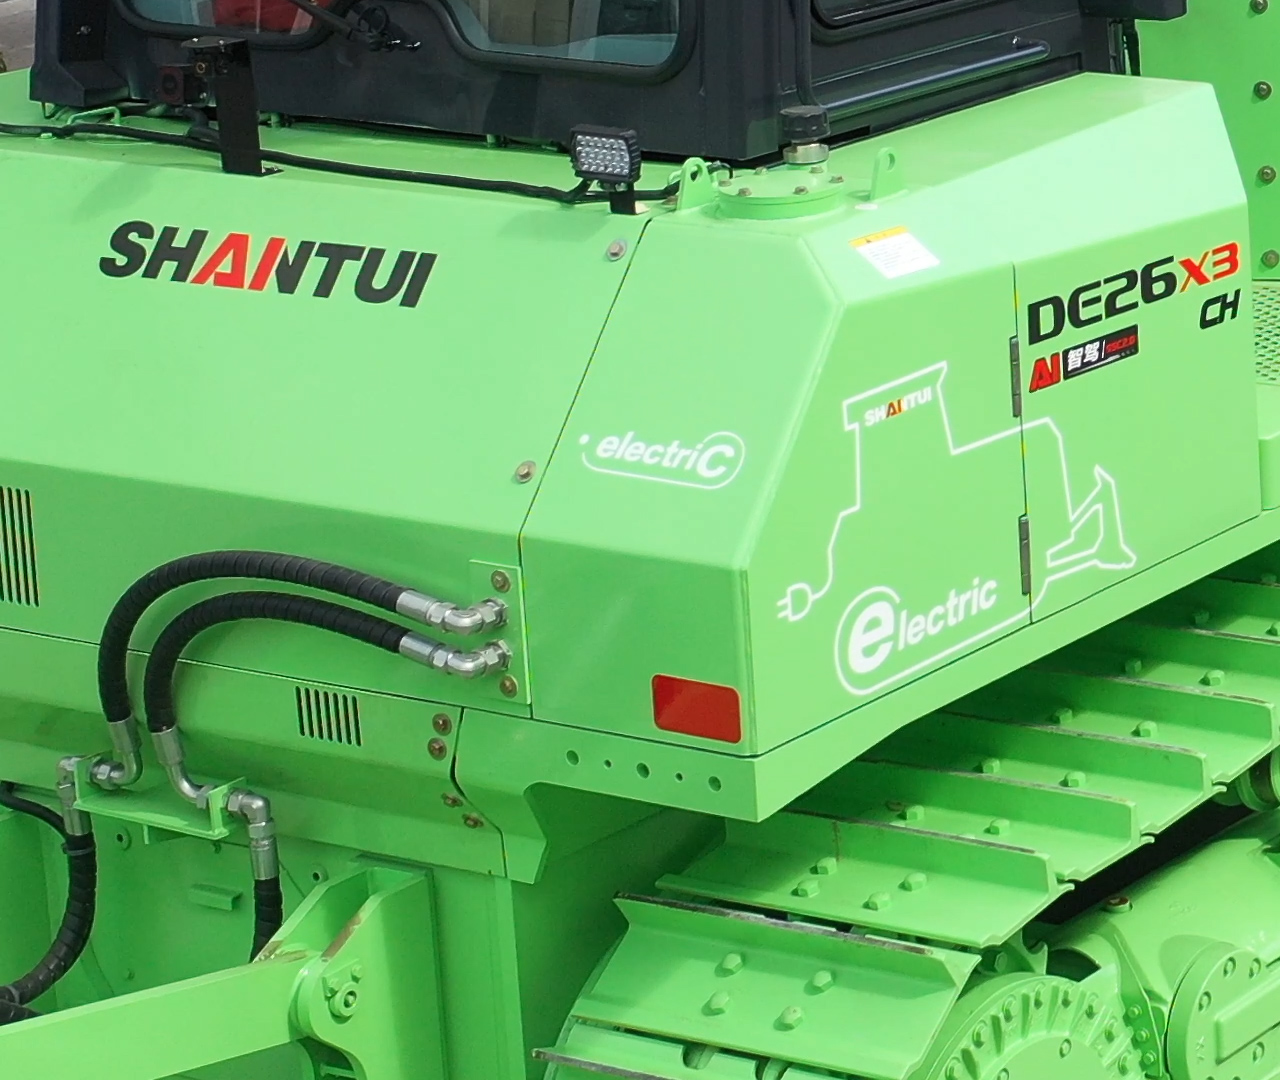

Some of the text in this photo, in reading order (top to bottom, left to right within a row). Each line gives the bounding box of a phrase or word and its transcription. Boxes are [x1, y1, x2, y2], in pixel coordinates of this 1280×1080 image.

[98, 219, 439, 309] SHANTUI
[1027, 241, 1240, 345] DE26X3
[1199, 288, 1242, 330] CH
[1028, 351, 1062, 393] AI
[864, 385, 933, 427] SHANTUI
[848, 576, 998, 676] electric
